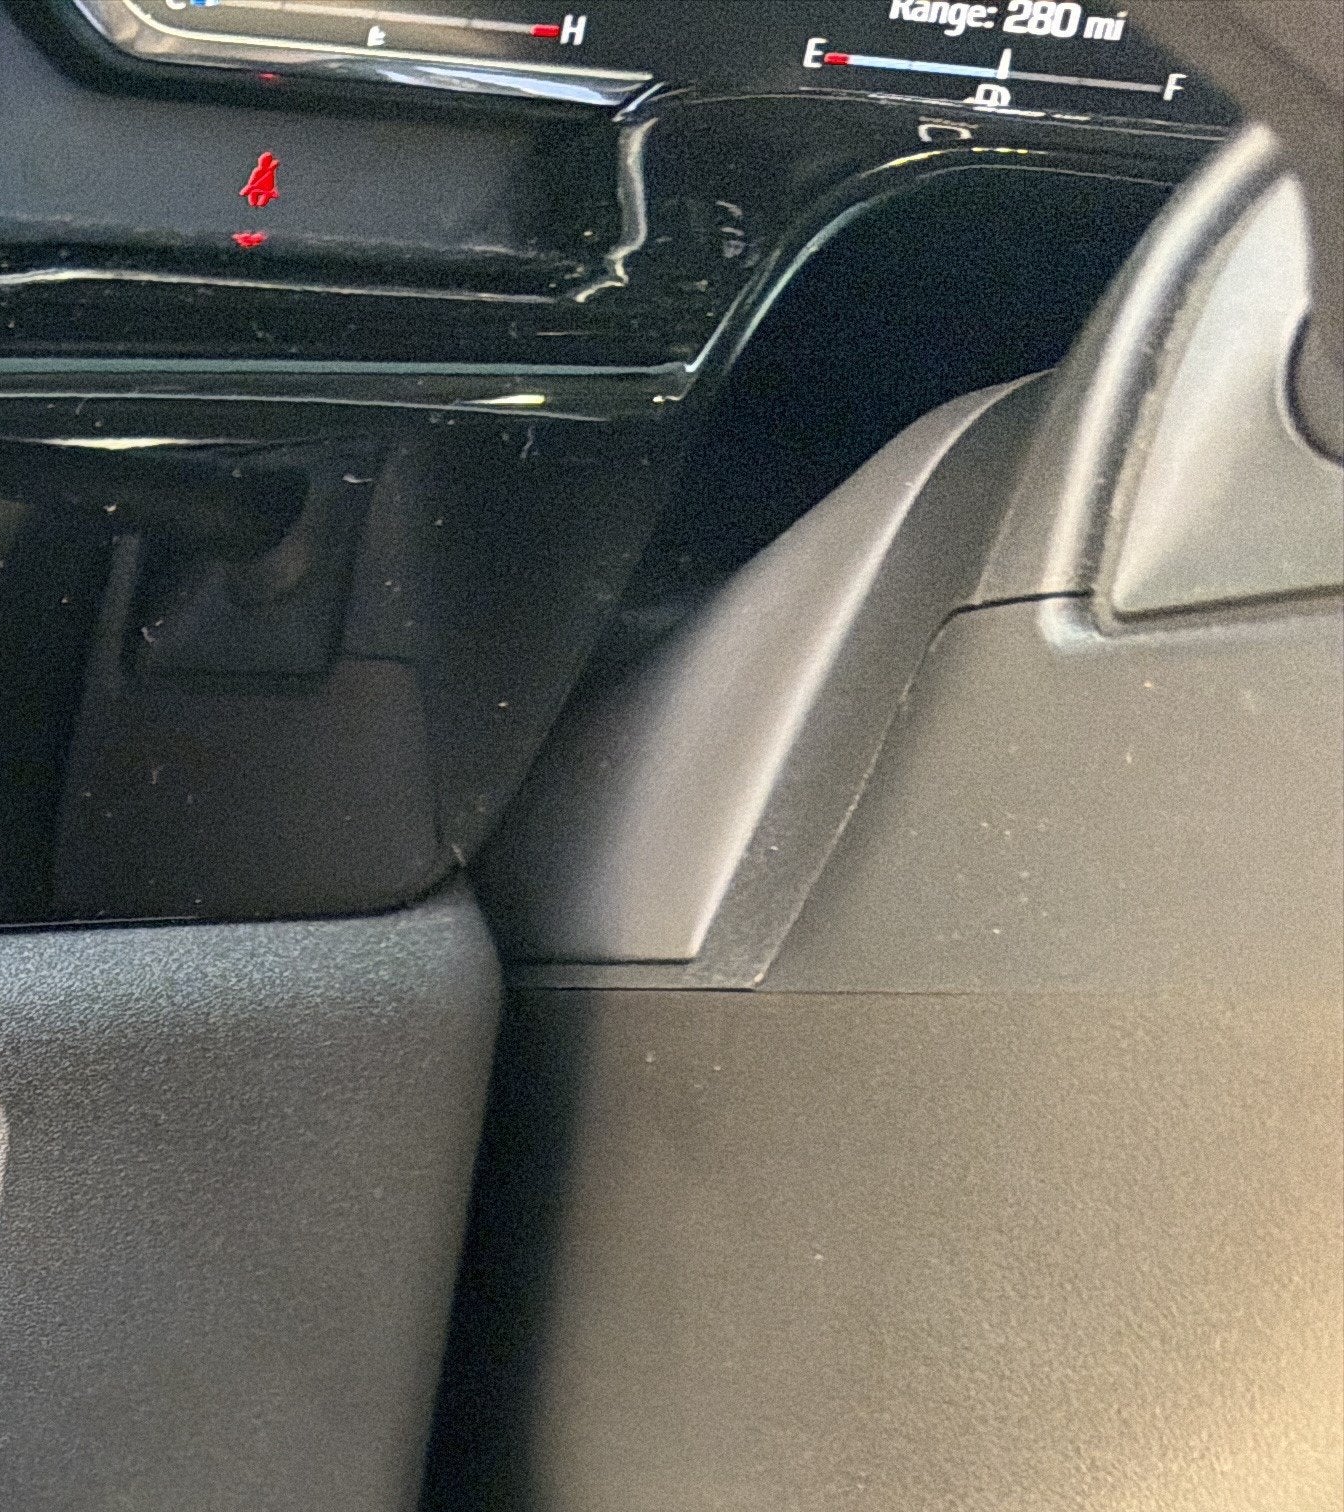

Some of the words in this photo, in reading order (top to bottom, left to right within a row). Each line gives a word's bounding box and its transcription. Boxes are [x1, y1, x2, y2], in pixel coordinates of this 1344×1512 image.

[559, 14, 587, 46] H
[889, 0, 998, 36] Range:
[1003, 0, 1080, 37] 280
[1083, 11, 1128, 40] mi
[803, 38, 826, 68] E
[1163, 73, 1187, 100] F
